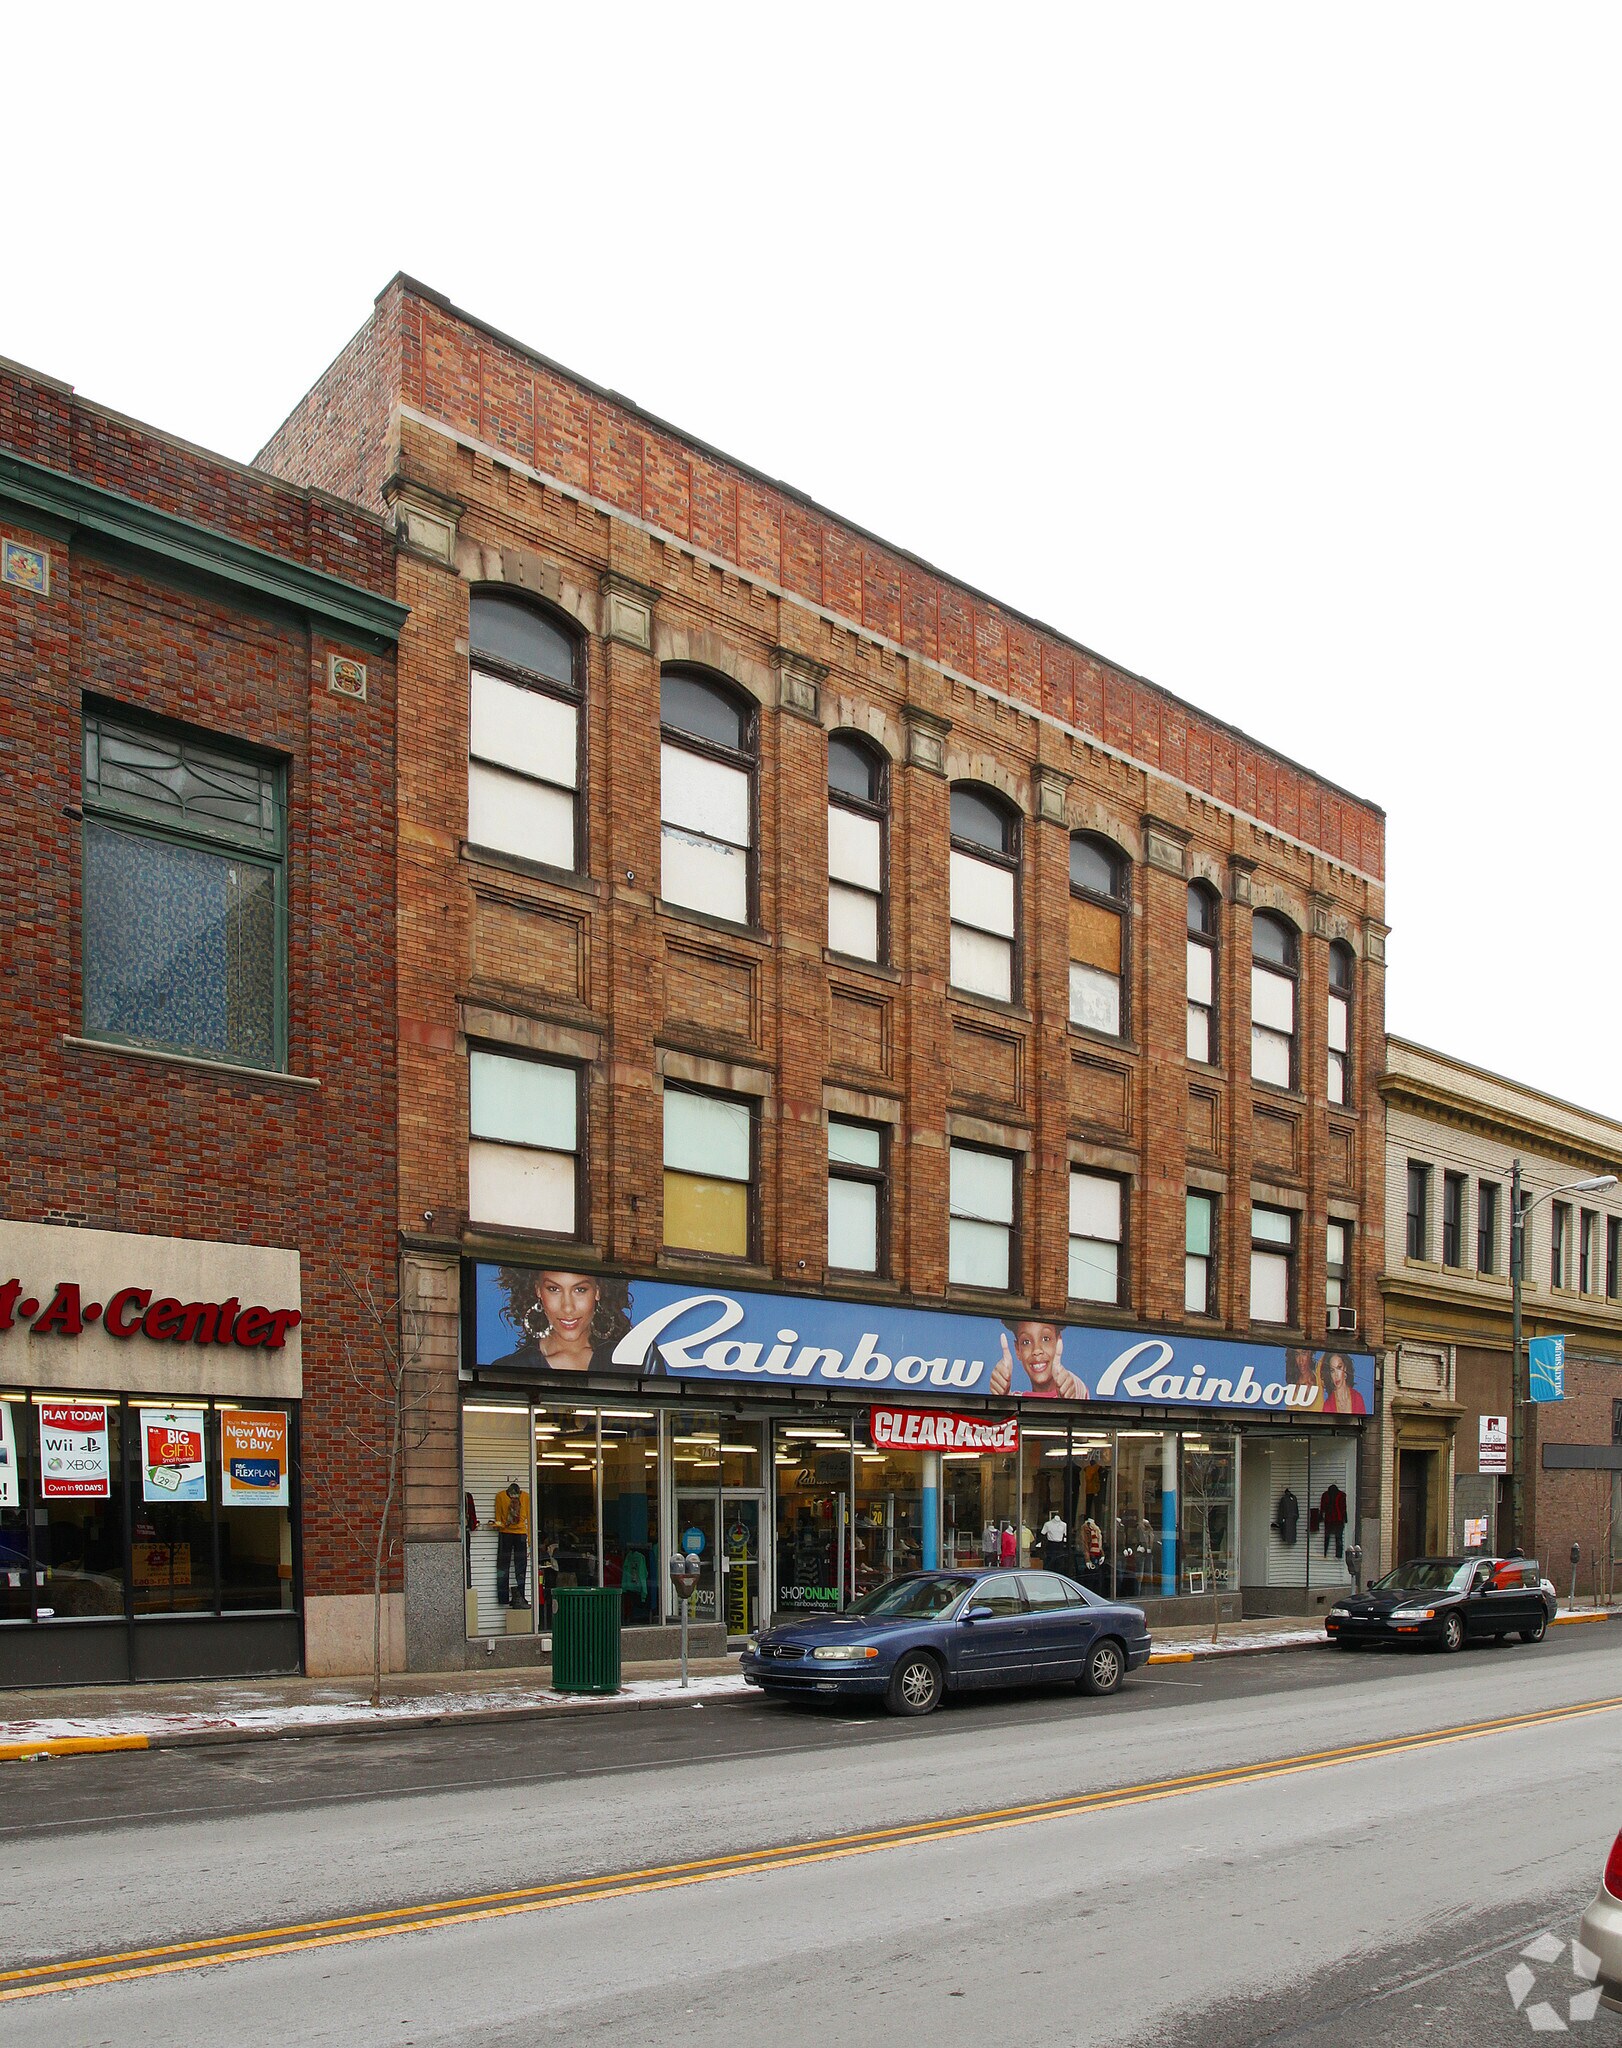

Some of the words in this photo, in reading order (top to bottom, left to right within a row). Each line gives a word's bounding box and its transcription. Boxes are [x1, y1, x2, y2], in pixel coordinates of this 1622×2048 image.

[611, 1294, 984, 1387] Rainbow
[1096, 1339, 1319, 1407] Rainbow
[1554, 1339, 1563, 1396] WILKINSBURG
[43, 1410, 68, 1420] PLAY
[70, 1411, 104, 1421] TODAY
[167, 1429, 190, 1444] BIG
[226, 1425, 254, 1437] New
[255, 1426, 283, 1441] Way
[874, 1411, 1018, 1447] CLEARANCE
[45, 1438, 73, 1451] Wii
[160, 1443, 195, 1458] GIFTS
[235, 1437, 248, 1449] to
[250, 1438, 274, 1453] Buy.
[66, 1459, 102, 1471] XBOX
[84, 1484, 104, 1492] DAYS!
